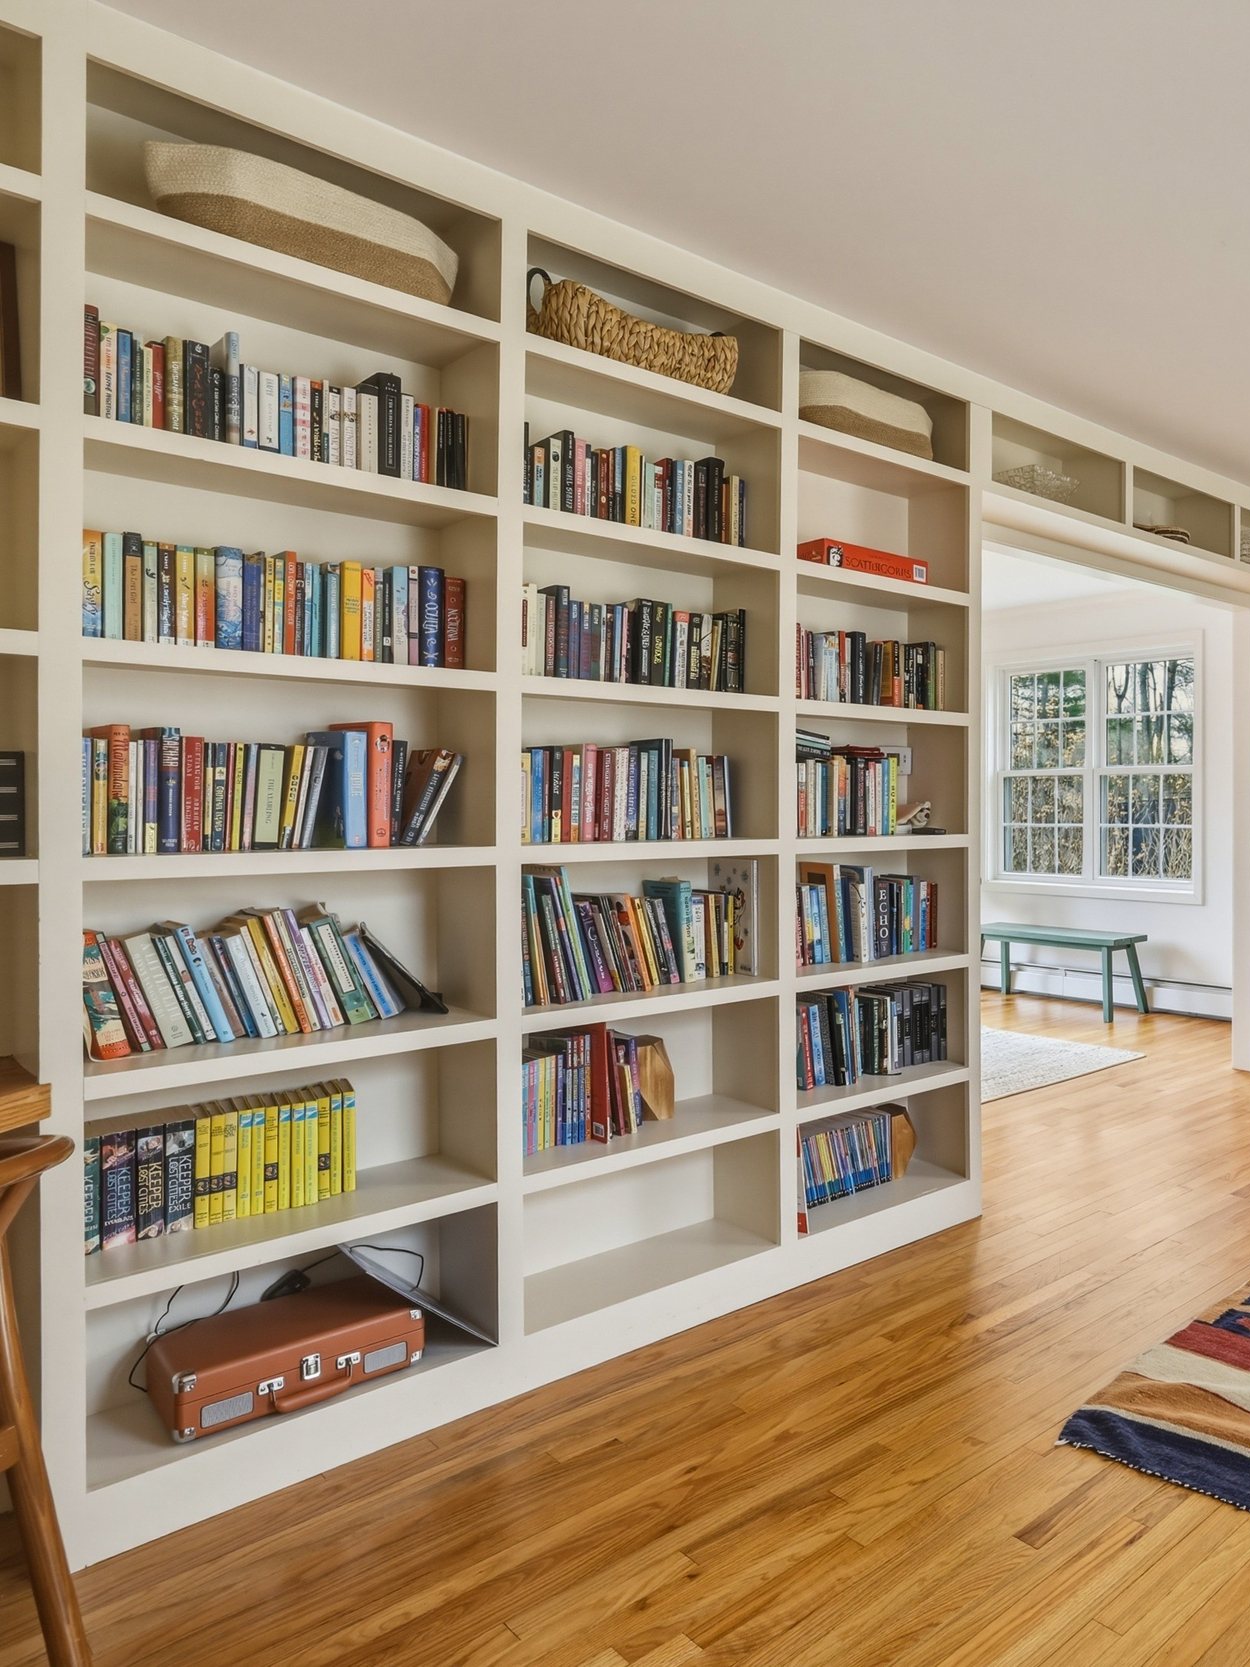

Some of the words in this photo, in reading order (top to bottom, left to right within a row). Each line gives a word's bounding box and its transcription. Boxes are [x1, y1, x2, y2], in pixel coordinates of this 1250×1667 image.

[879, 890, 889, 939] ECHO
[117, 1166, 131, 1217] KEEPER
[148, 1162, 162, 1211] KEEPER
[179, 1155, 191, 1202] KEEPER
